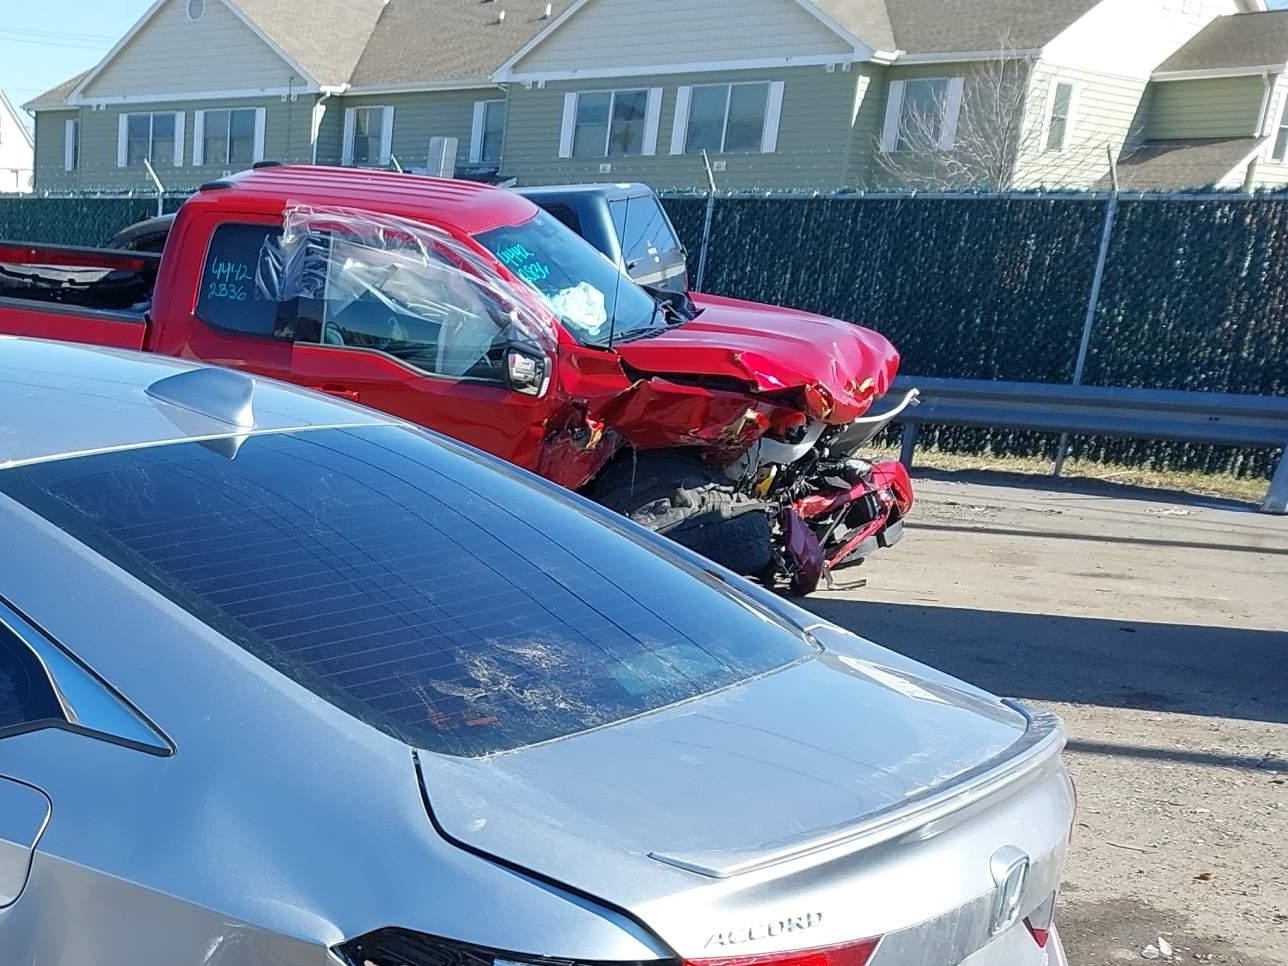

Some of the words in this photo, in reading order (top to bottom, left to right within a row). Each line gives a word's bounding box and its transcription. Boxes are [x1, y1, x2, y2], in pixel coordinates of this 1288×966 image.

[212, 256, 252, 282] 4442
[208, 282, 247, 300] 2836
[703, 912, 823, 949] ACCORD
